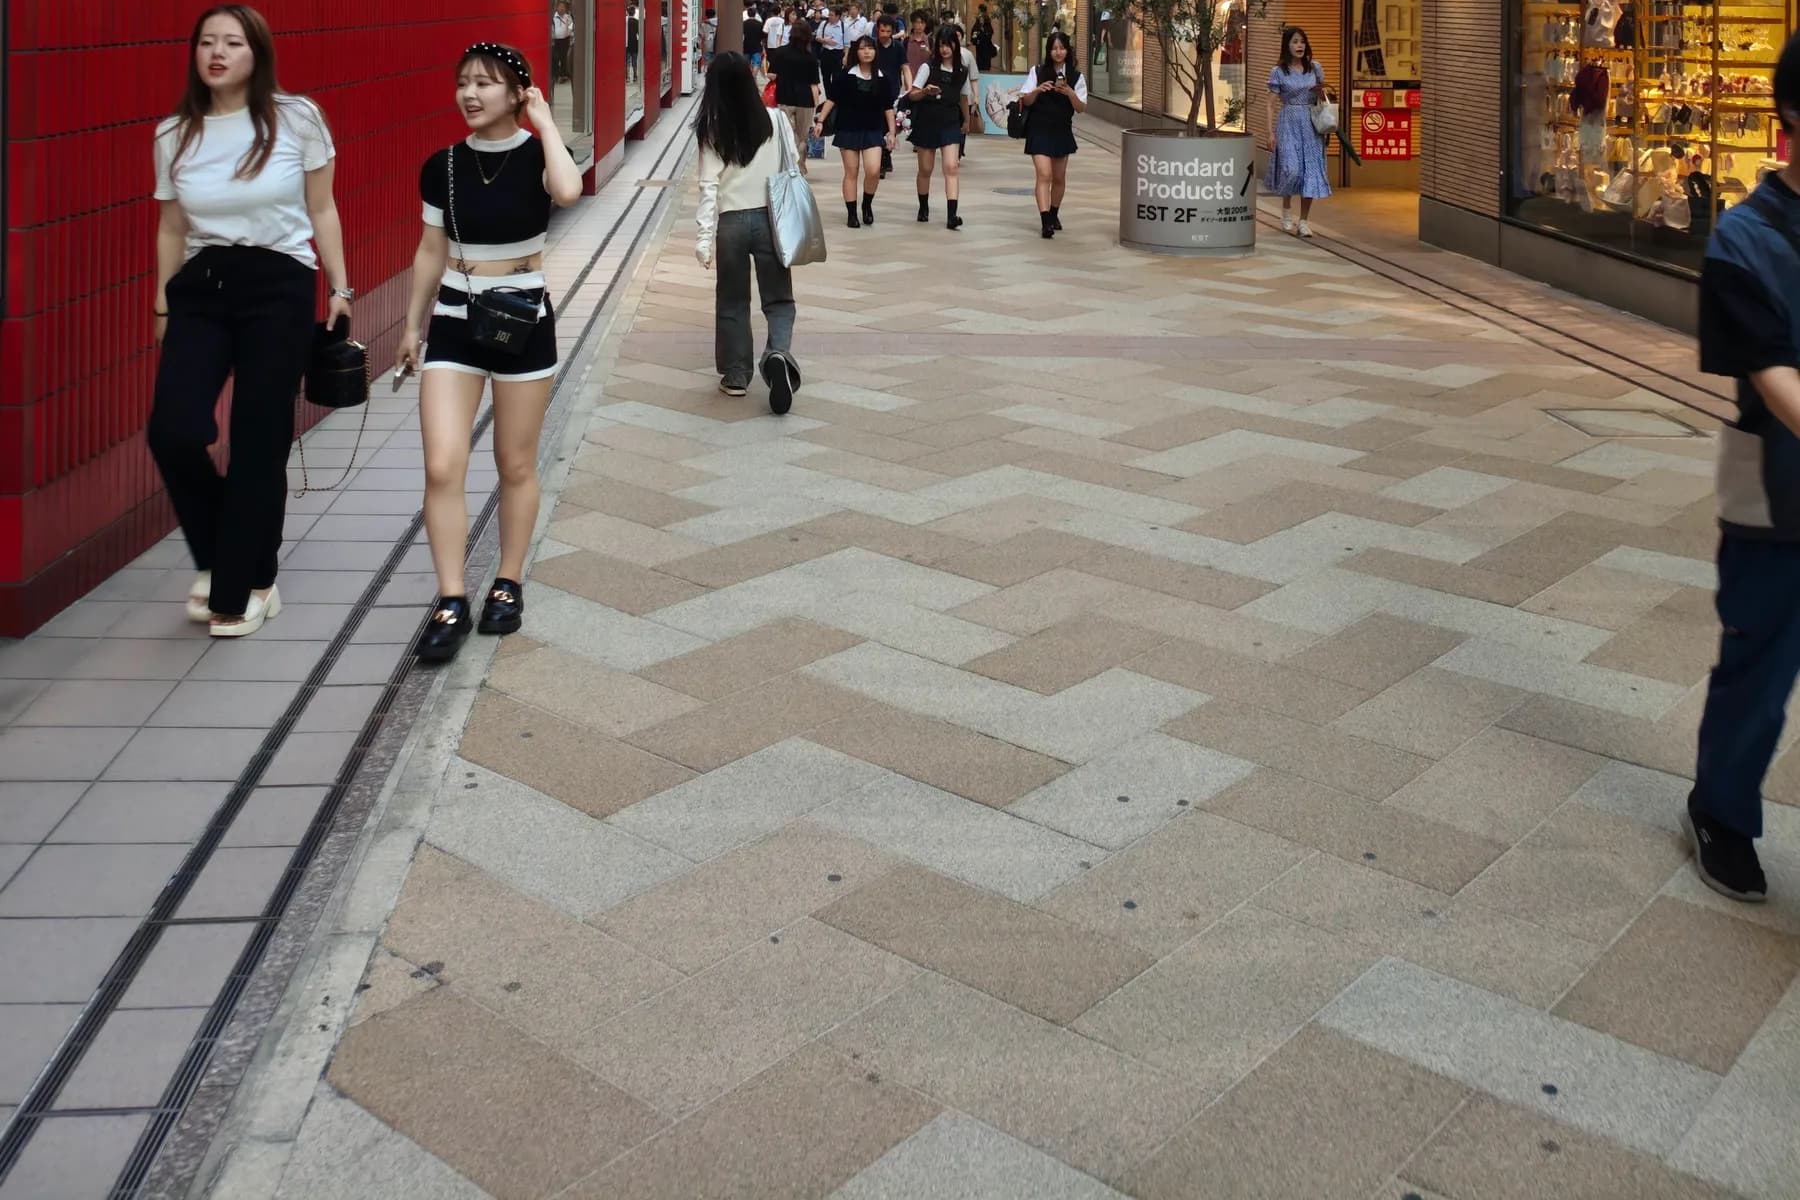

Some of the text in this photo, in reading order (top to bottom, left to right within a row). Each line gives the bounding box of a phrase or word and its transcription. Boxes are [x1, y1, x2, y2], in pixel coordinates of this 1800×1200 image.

[1137, 154, 1234, 177] Standard
[1136, 177, 1234, 200] Products
[1136, 204, 1198, 223] EST 2F
